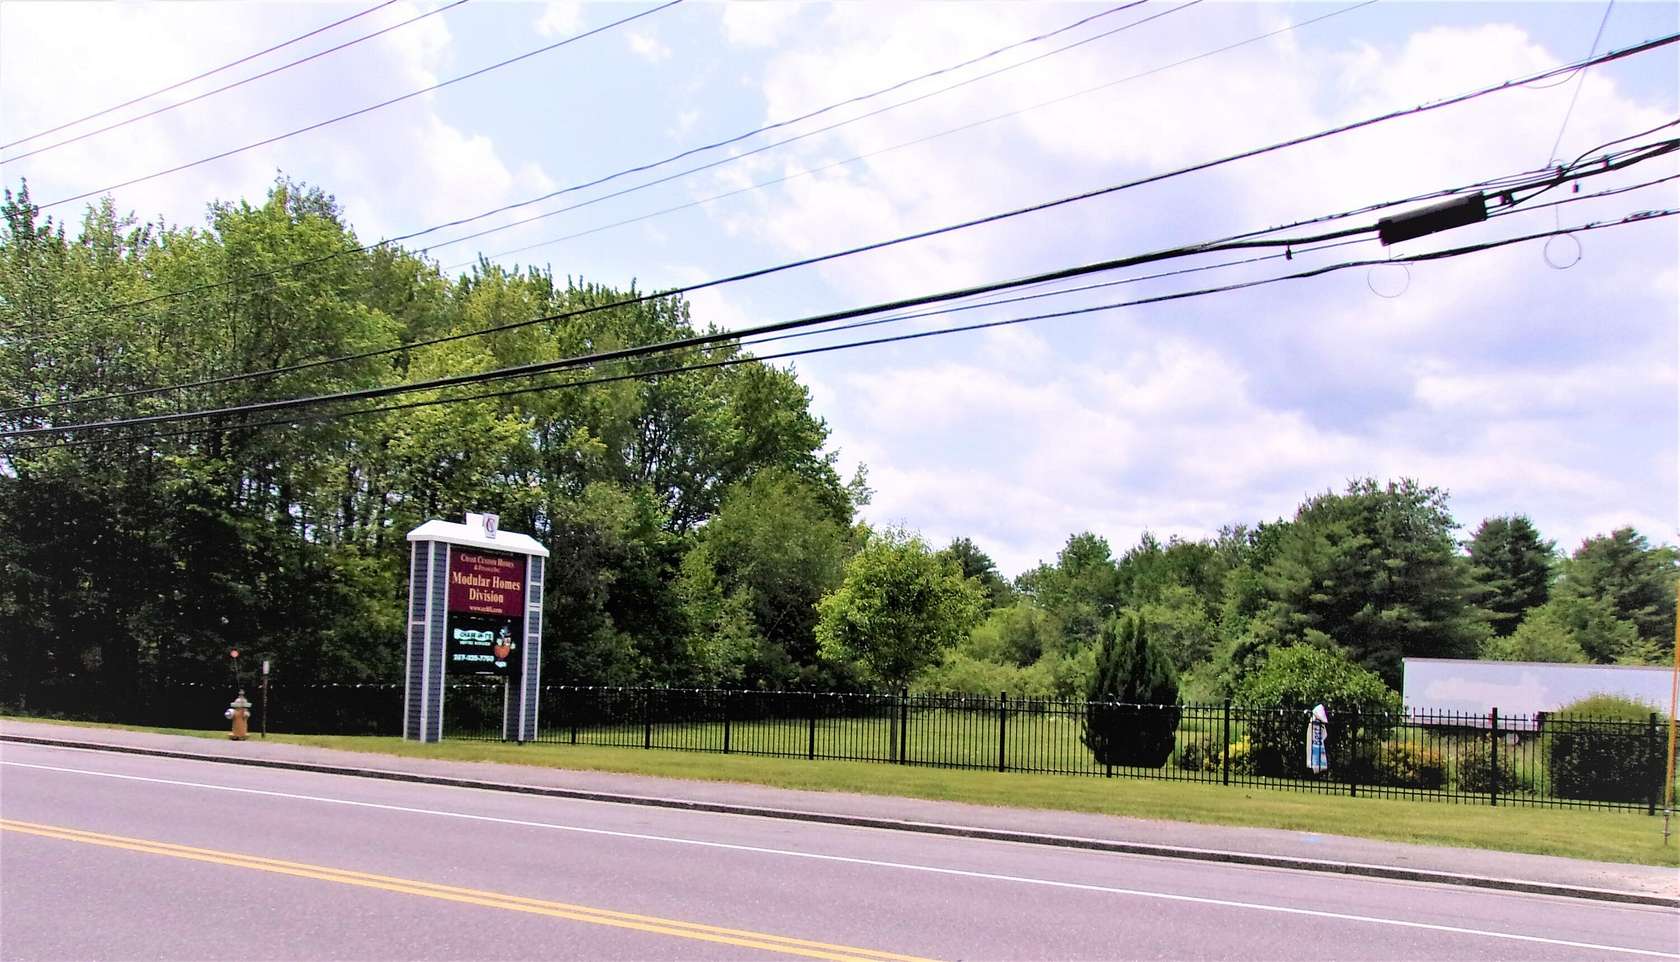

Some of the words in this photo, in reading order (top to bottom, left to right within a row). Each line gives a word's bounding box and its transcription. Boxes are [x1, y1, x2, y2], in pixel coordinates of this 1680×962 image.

[452, 571, 491, 587] Modular
[492, 576, 521, 591] Homes
[469, 588, 504, 604] Division
